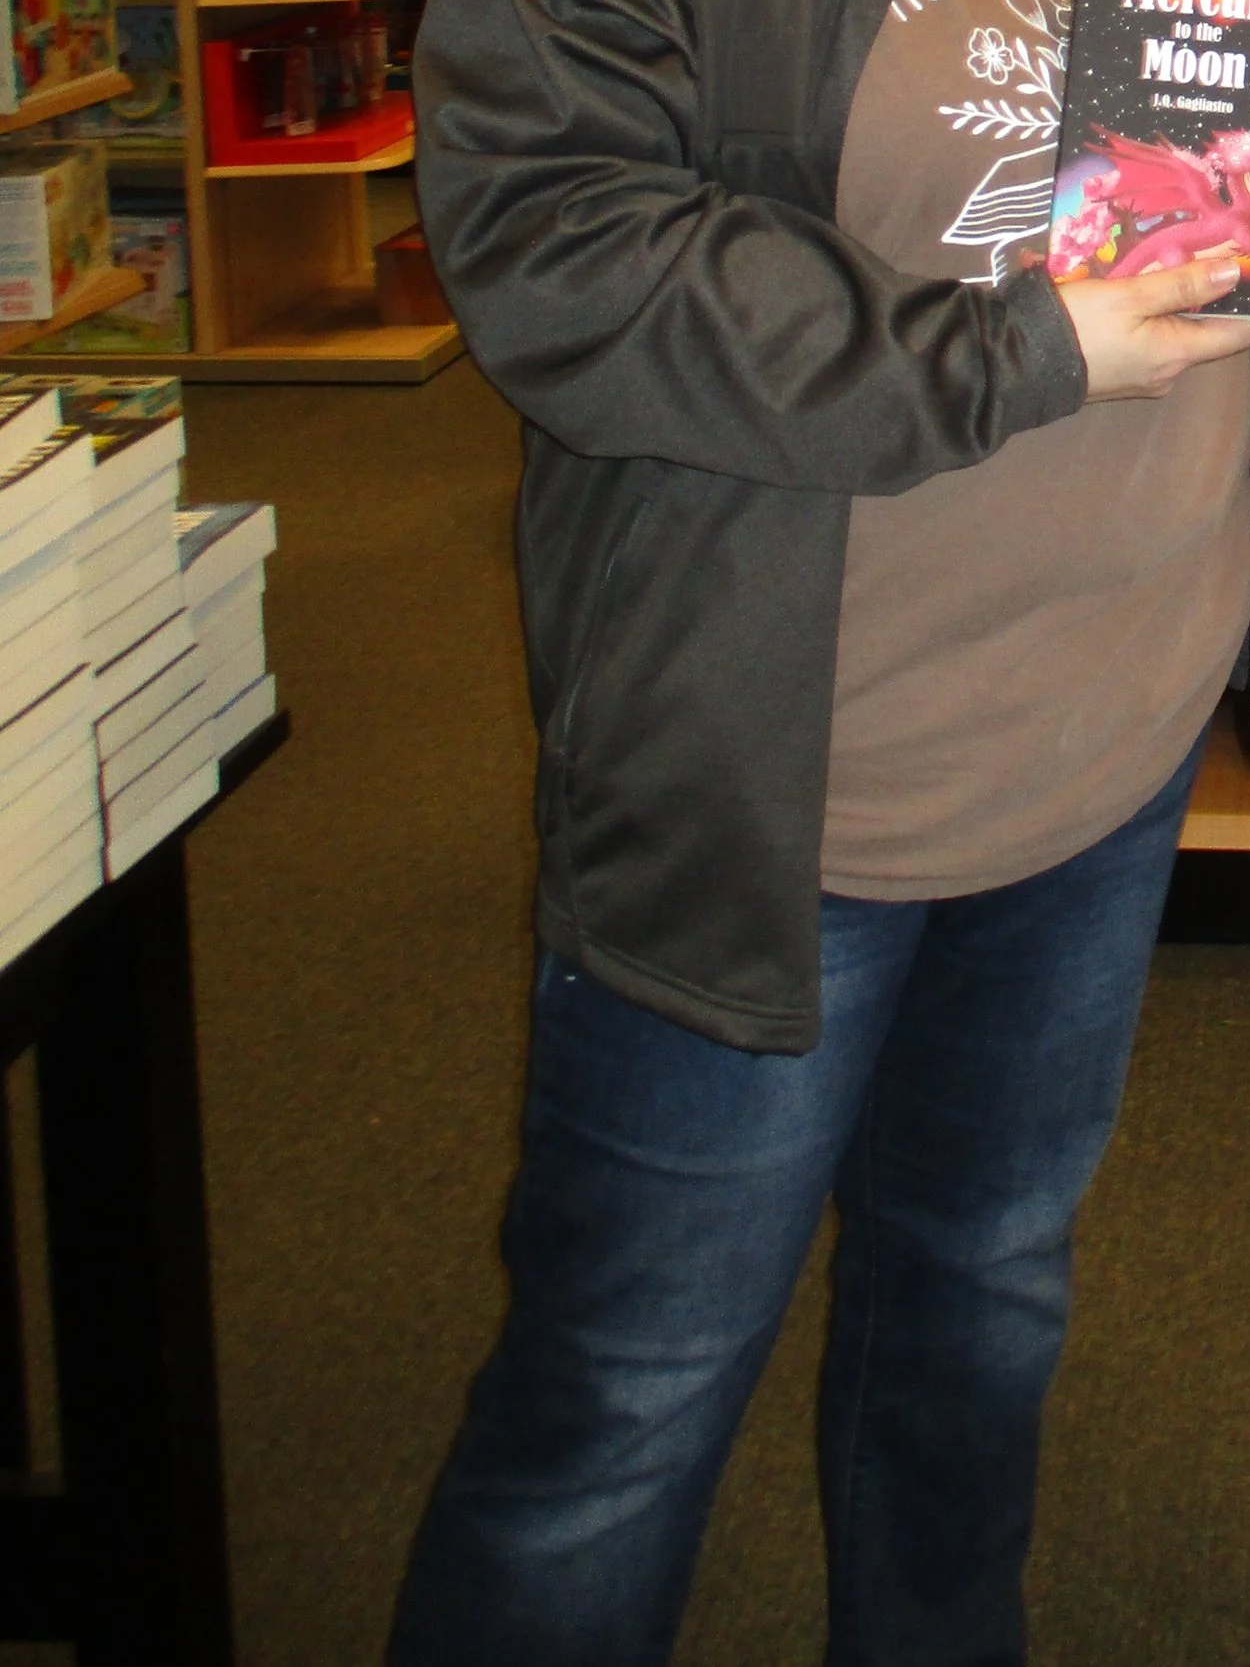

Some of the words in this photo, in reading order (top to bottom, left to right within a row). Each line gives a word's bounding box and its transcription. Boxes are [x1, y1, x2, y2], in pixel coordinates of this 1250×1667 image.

[1174, 20, 1192, 39] to
[1196, 22, 1223, 42] the
[1142, 38, 1247, 89] Moon
[1152, 93, 1176, 109] J.Q.
[1177, 95, 1235, 114] Gagliastro
